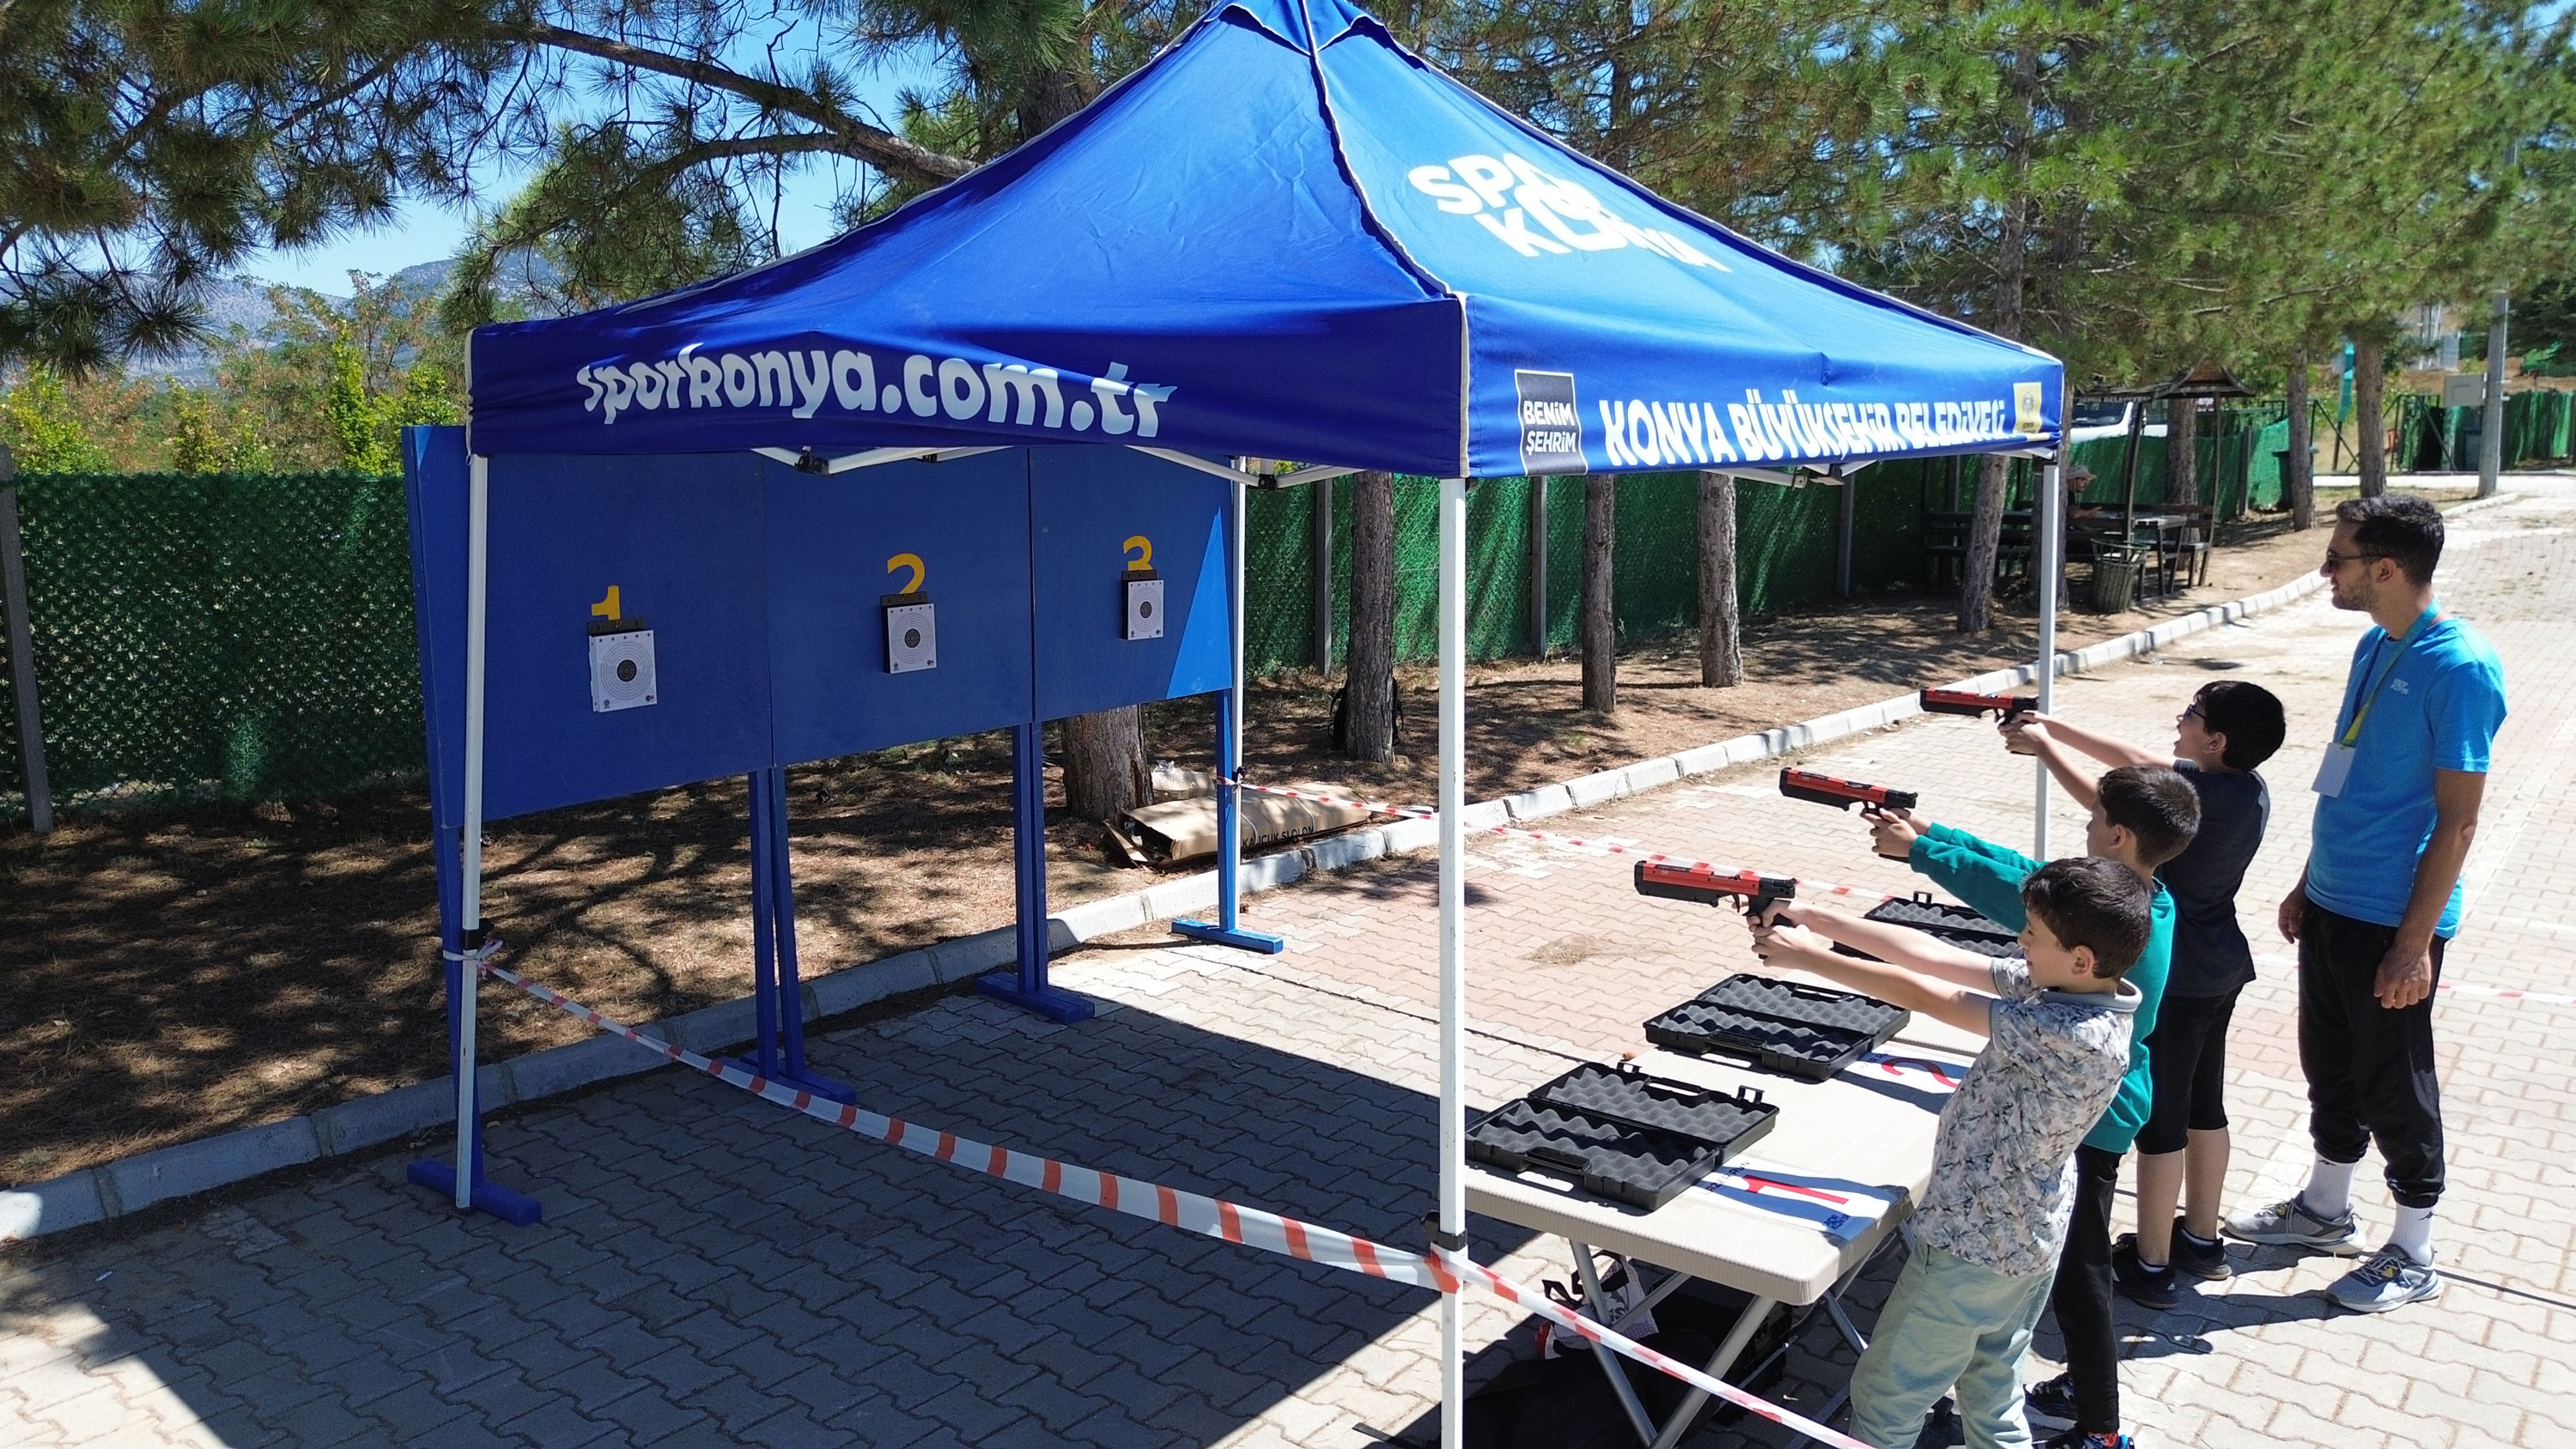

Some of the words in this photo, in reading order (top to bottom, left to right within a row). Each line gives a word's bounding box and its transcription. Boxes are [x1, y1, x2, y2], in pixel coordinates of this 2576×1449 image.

[576, 343, 1177, 438] sporkonya.com.tr
[1523, 401, 1576, 427] BENİM
[1599, 399, 1738, 466] KONYA
[1727, 389, 1908, 461] BÜYÜKŞEHİR
[1526, 431, 1577, 456] ŞEHRİM
[1123, 536, 1153, 571] 3
[887, 553, 926, 594] 2
[592, 585, 621, 621] 1
[1743, 1173, 1850, 1205] 1
